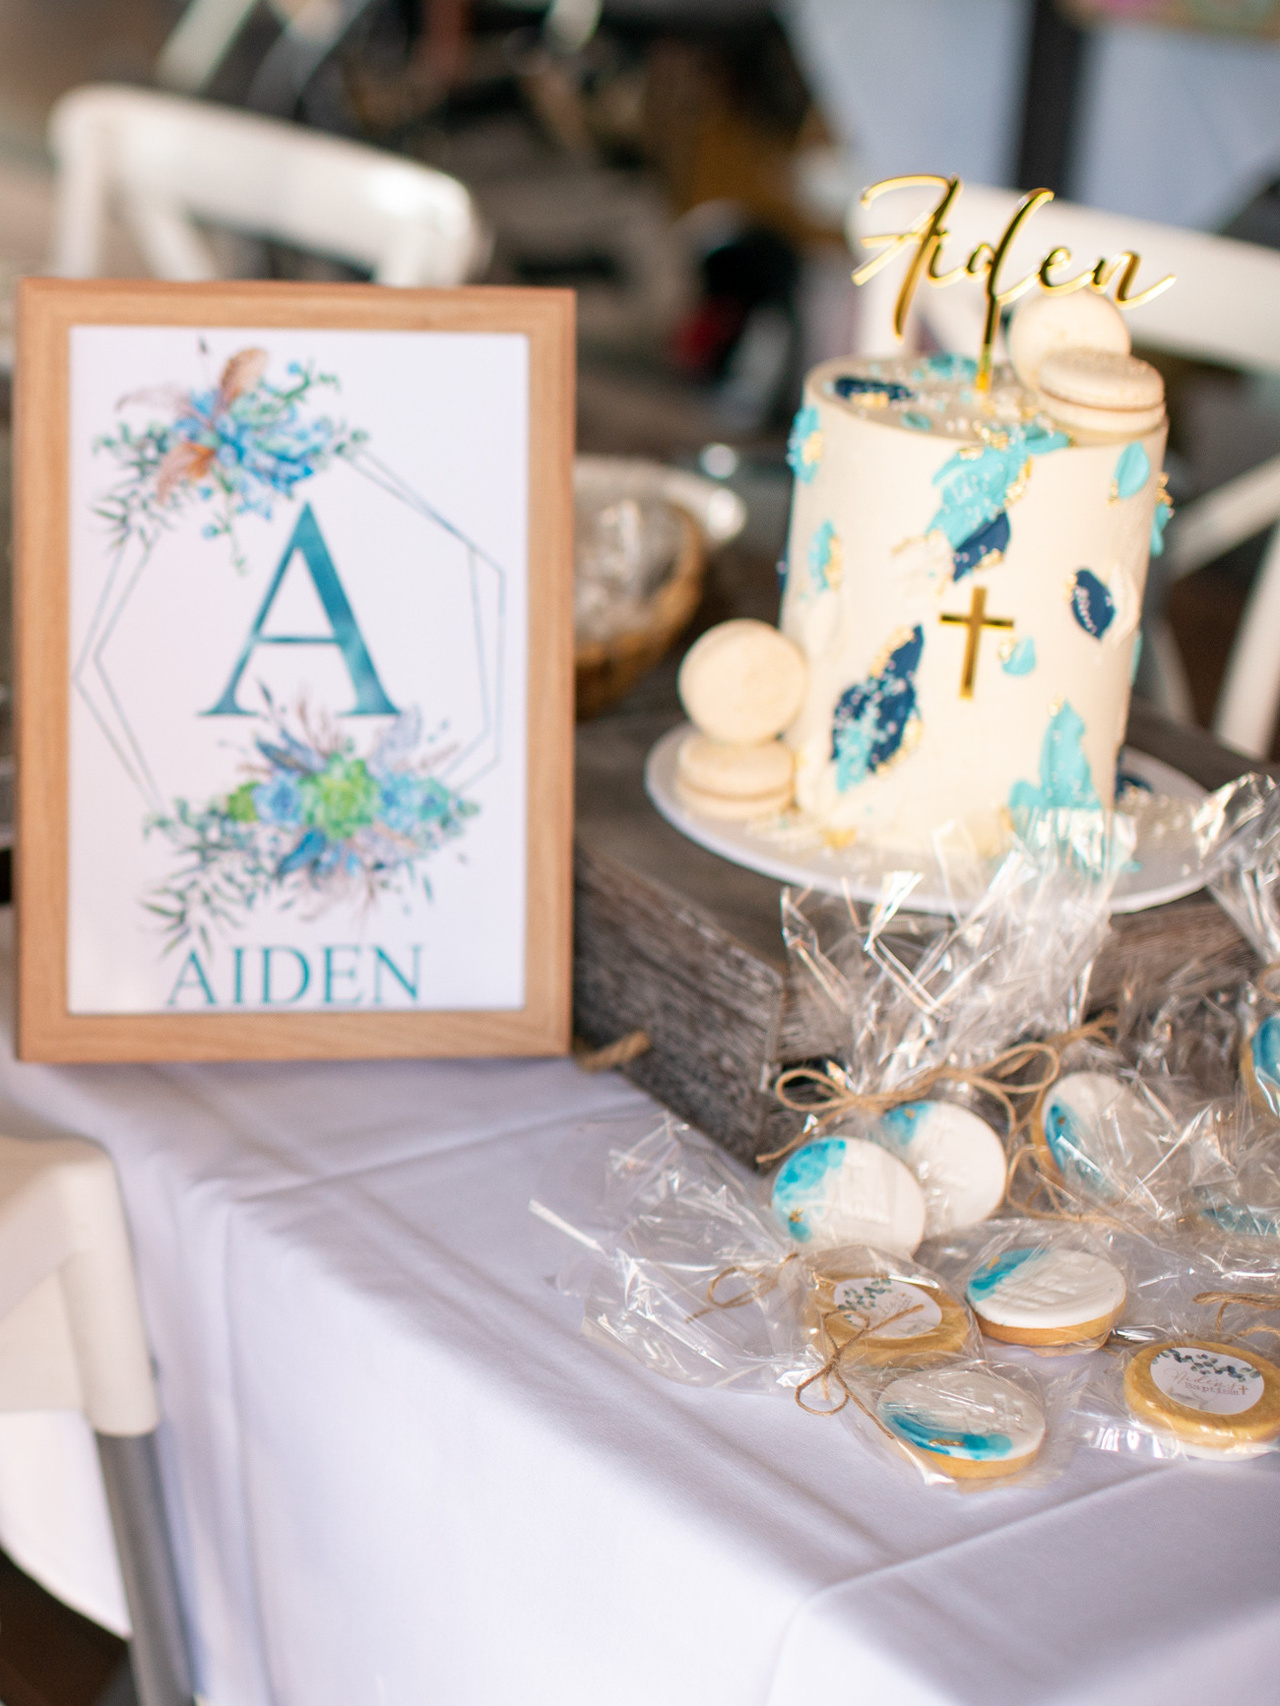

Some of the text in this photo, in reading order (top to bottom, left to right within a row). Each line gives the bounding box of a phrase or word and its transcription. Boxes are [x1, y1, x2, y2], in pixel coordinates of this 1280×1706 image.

[852, 172, 1177, 345] Aiden
[195, 500, 403, 717] A
[166, 944, 424, 1006] AIDEN
